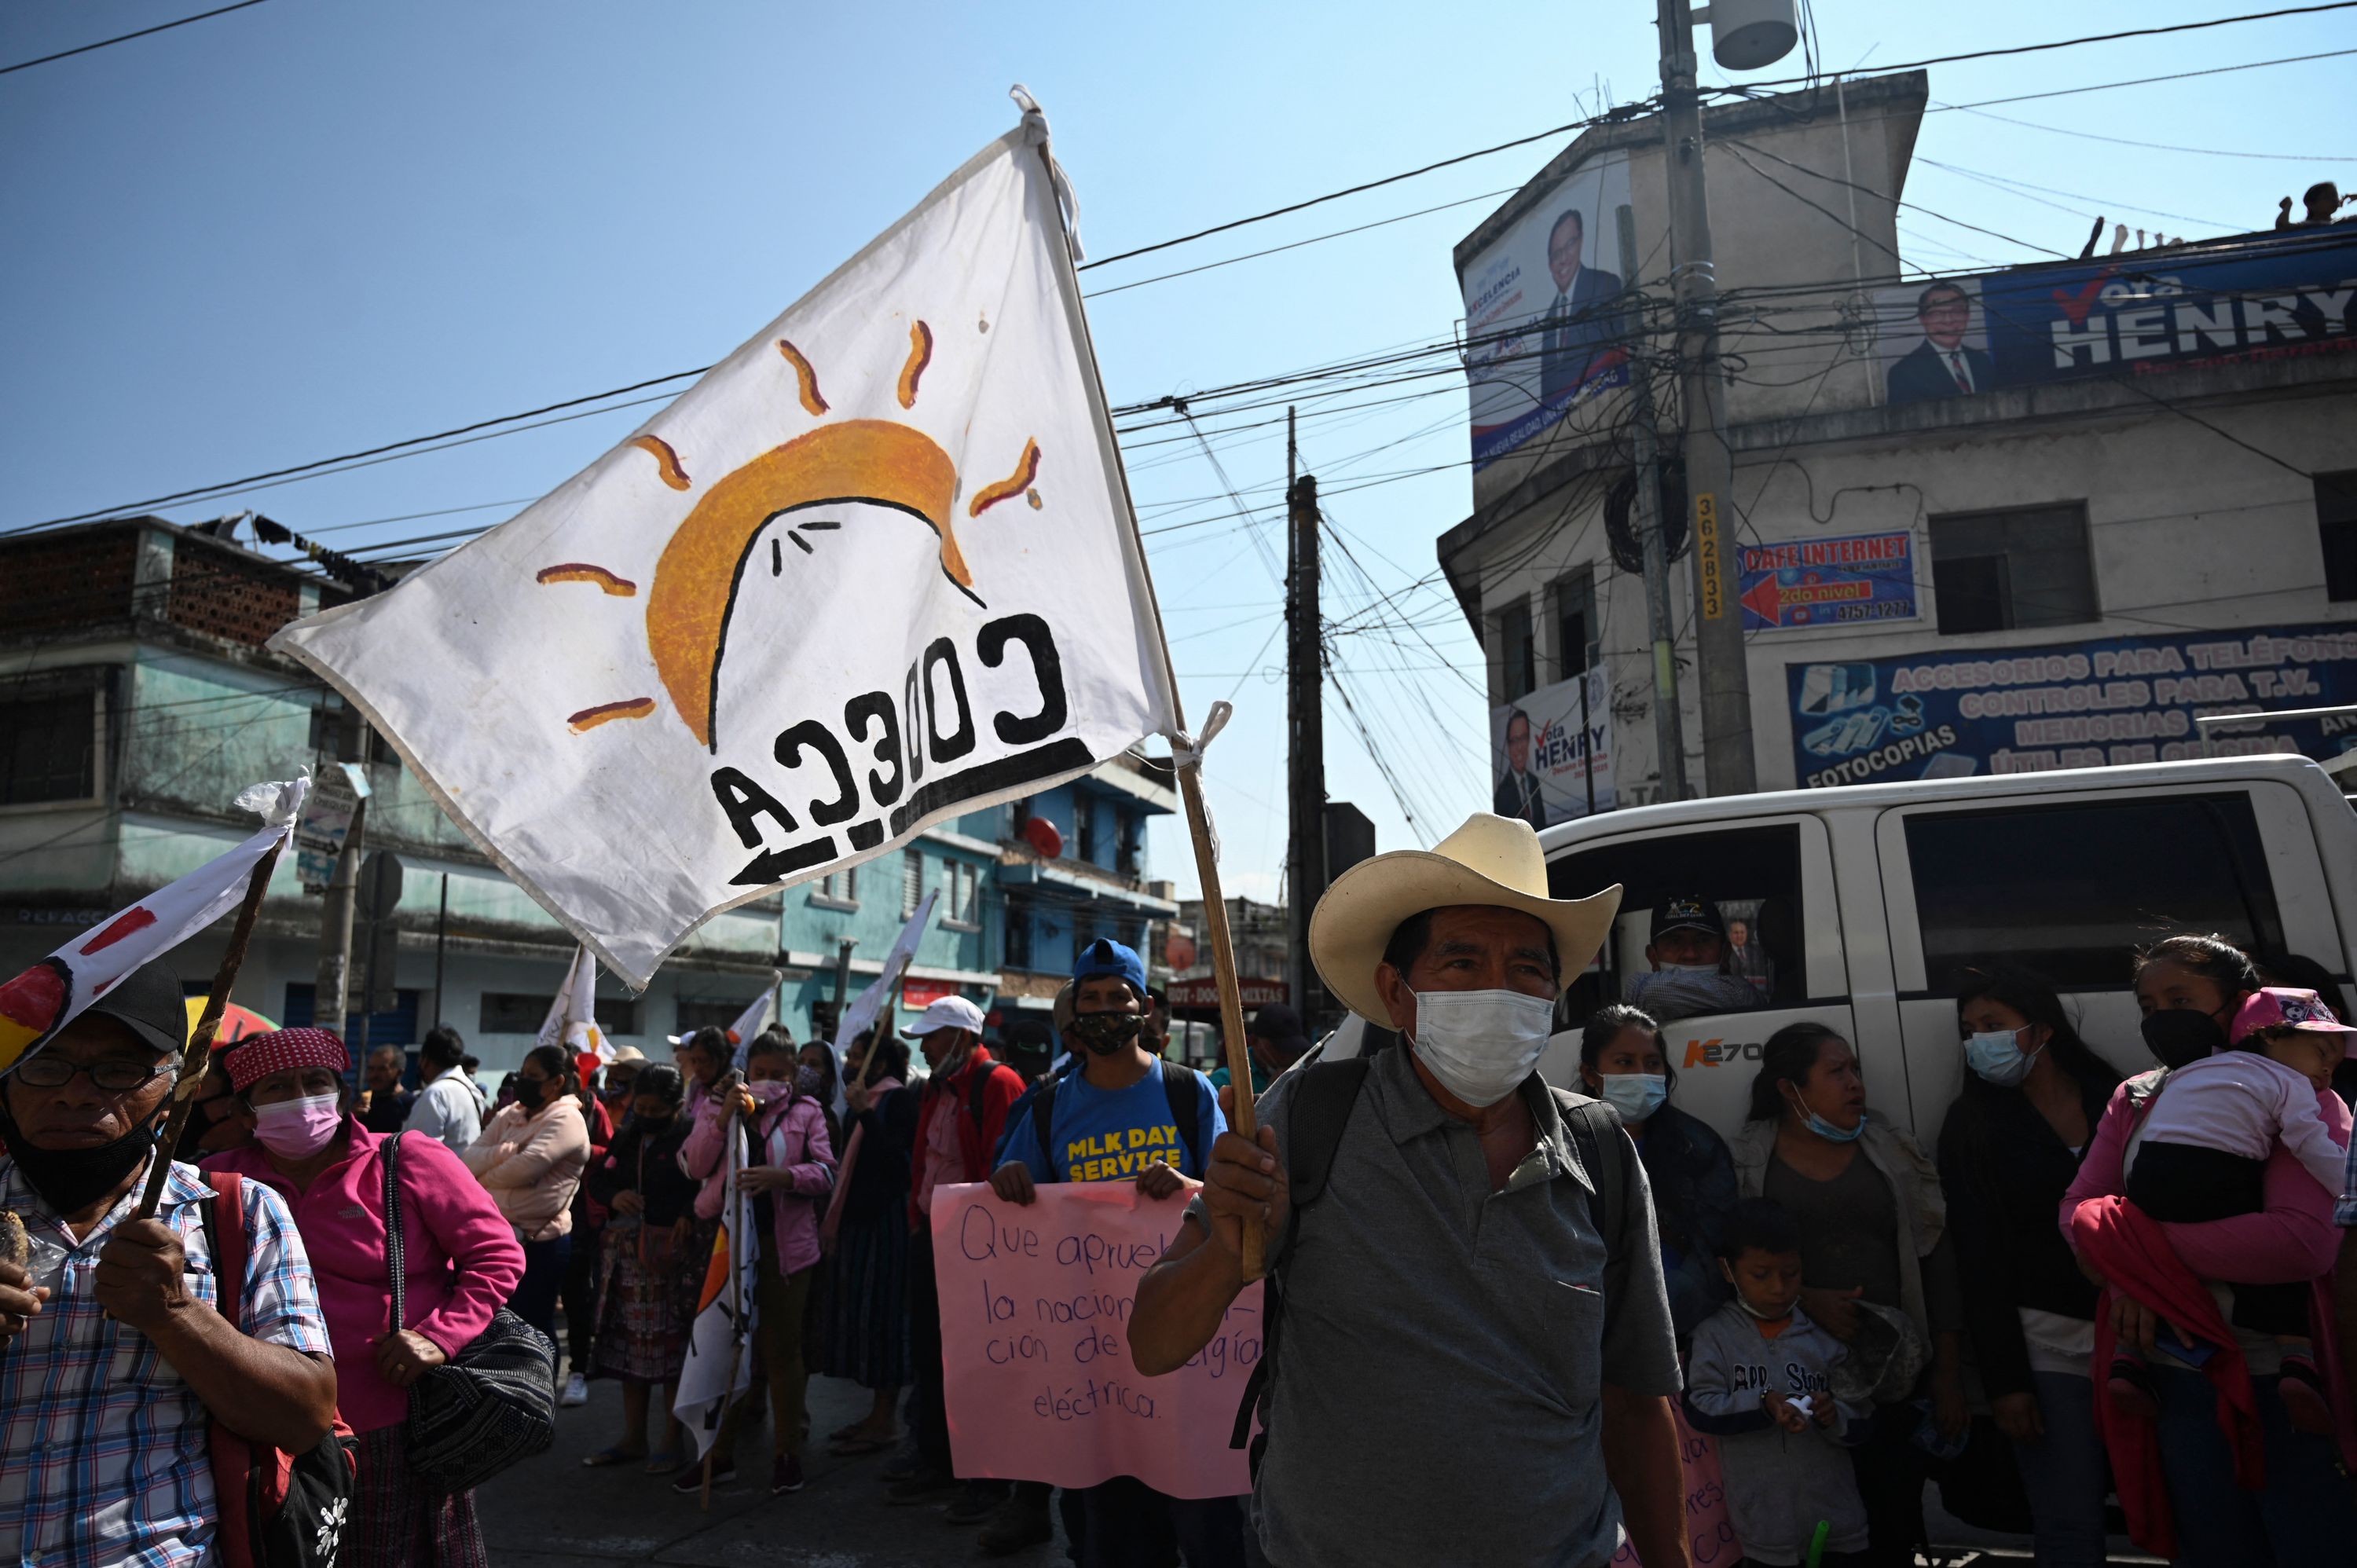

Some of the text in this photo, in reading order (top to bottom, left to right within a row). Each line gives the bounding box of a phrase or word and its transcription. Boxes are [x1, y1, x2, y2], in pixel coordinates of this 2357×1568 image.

[2051, 277, 2357, 368] HENRY
[1699, 498, 1718, 617] 362833
[1744, 536, 1908, 573] CAFE INTERNET
[1780, 583, 1861, 604] 2do nivel
[1891, 652, 2090, 694] ACCESORIOS
[2094, 646, 2187, 678] PARA
[1959, 669, 2321, 720] CONTROLES PARA T.V.
[2014, 710, 2190, 746] MEMORIAS
[1068, 1124, 1178, 1162] MLK DAY
[961, 1204, 1039, 1262] Que
[984, 1279, 1014, 1324] la
[1075, 1325, 1119, 1364] de
